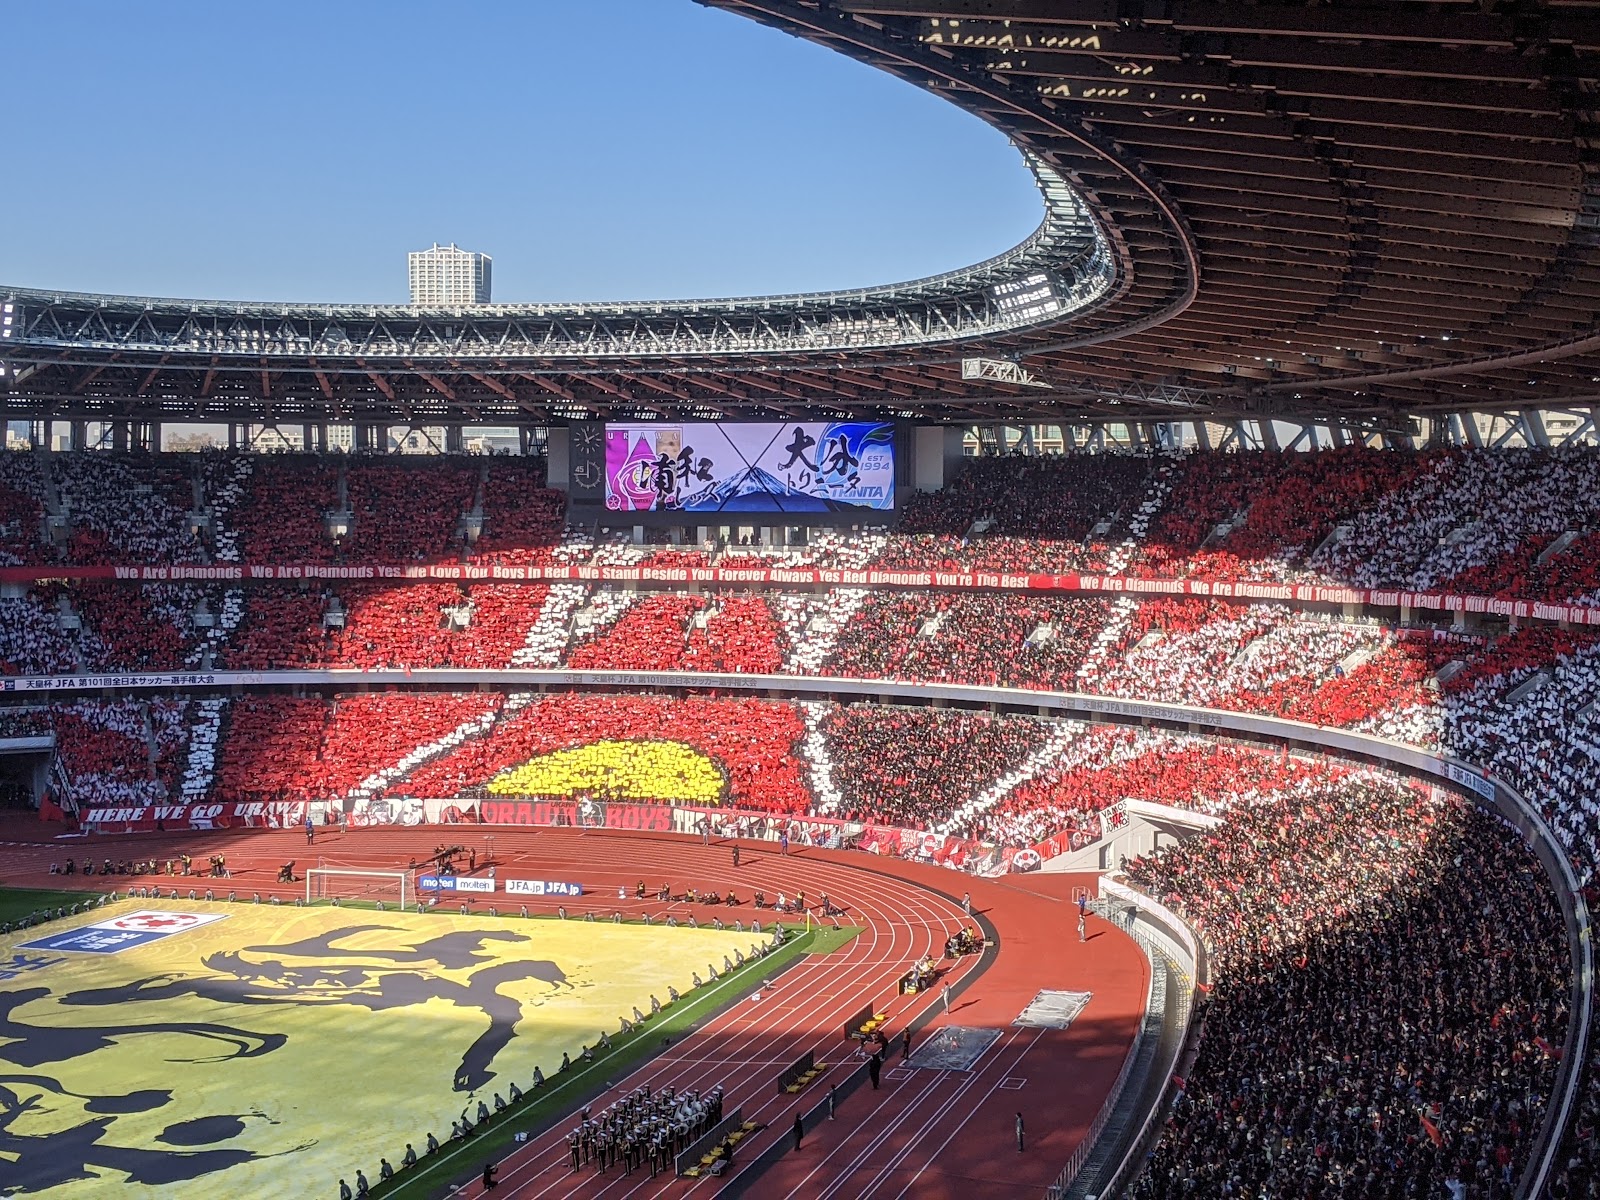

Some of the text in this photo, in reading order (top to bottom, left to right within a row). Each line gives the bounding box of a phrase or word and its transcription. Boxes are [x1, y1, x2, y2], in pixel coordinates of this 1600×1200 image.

[607, 431, 680, 440] URAWA
[860, 462, 890, 471] 1994
[115, 565, 1029, 588] We Are Diamonds We Are Diamonds Yes We Love You Boys In Red We Stand Beside You Forever Always Yes Red Diamonds You're The Best
[1080, 576, 1099, 590] We
[1101, 577, 1123, 591] Are
[1125, 578, 1184, 593] Diamonds
[1190, 580, 1210, 595] We
[1212, 581, 1232, 597] Are
[1234, 583, 1293, 600] Diamonds
[1315, 587, 1365, 604] Together
[1370, 590, 1398, 606] Hand
[1400, 591, 1412, 607] In
[1413, 593, 1442, 610] Hand
[1445, 595, 1463, 611] We
[1465, 595, 1486, 612] Will
[1570, 606, 1584, 623] For
[25, 680, 53, 690] 天皇杯
[55, 679, 76, 689] JFA
[78, 675, 215, 688] 第101回全日本サッカー選手権大会
[592, 675, 615, 684] 天皇杯
[617, 675, 636, 684] JFA
[1105, 702, 1121, 713] JFA
[85, 807, 147, 822] HERE
[153, 805, 187, 820] WE
[191, 804, 224, 819] GO
[1101, 800, 1127, 818] VAMOS
[606, 803, 671, 831] BOYS
[423, 878, 453, 888] moten
[460, 879, 490, 889] molten
[509, 881, 541, 893] JFA.jp
[546, 882, 579, 895] JFA.jp
